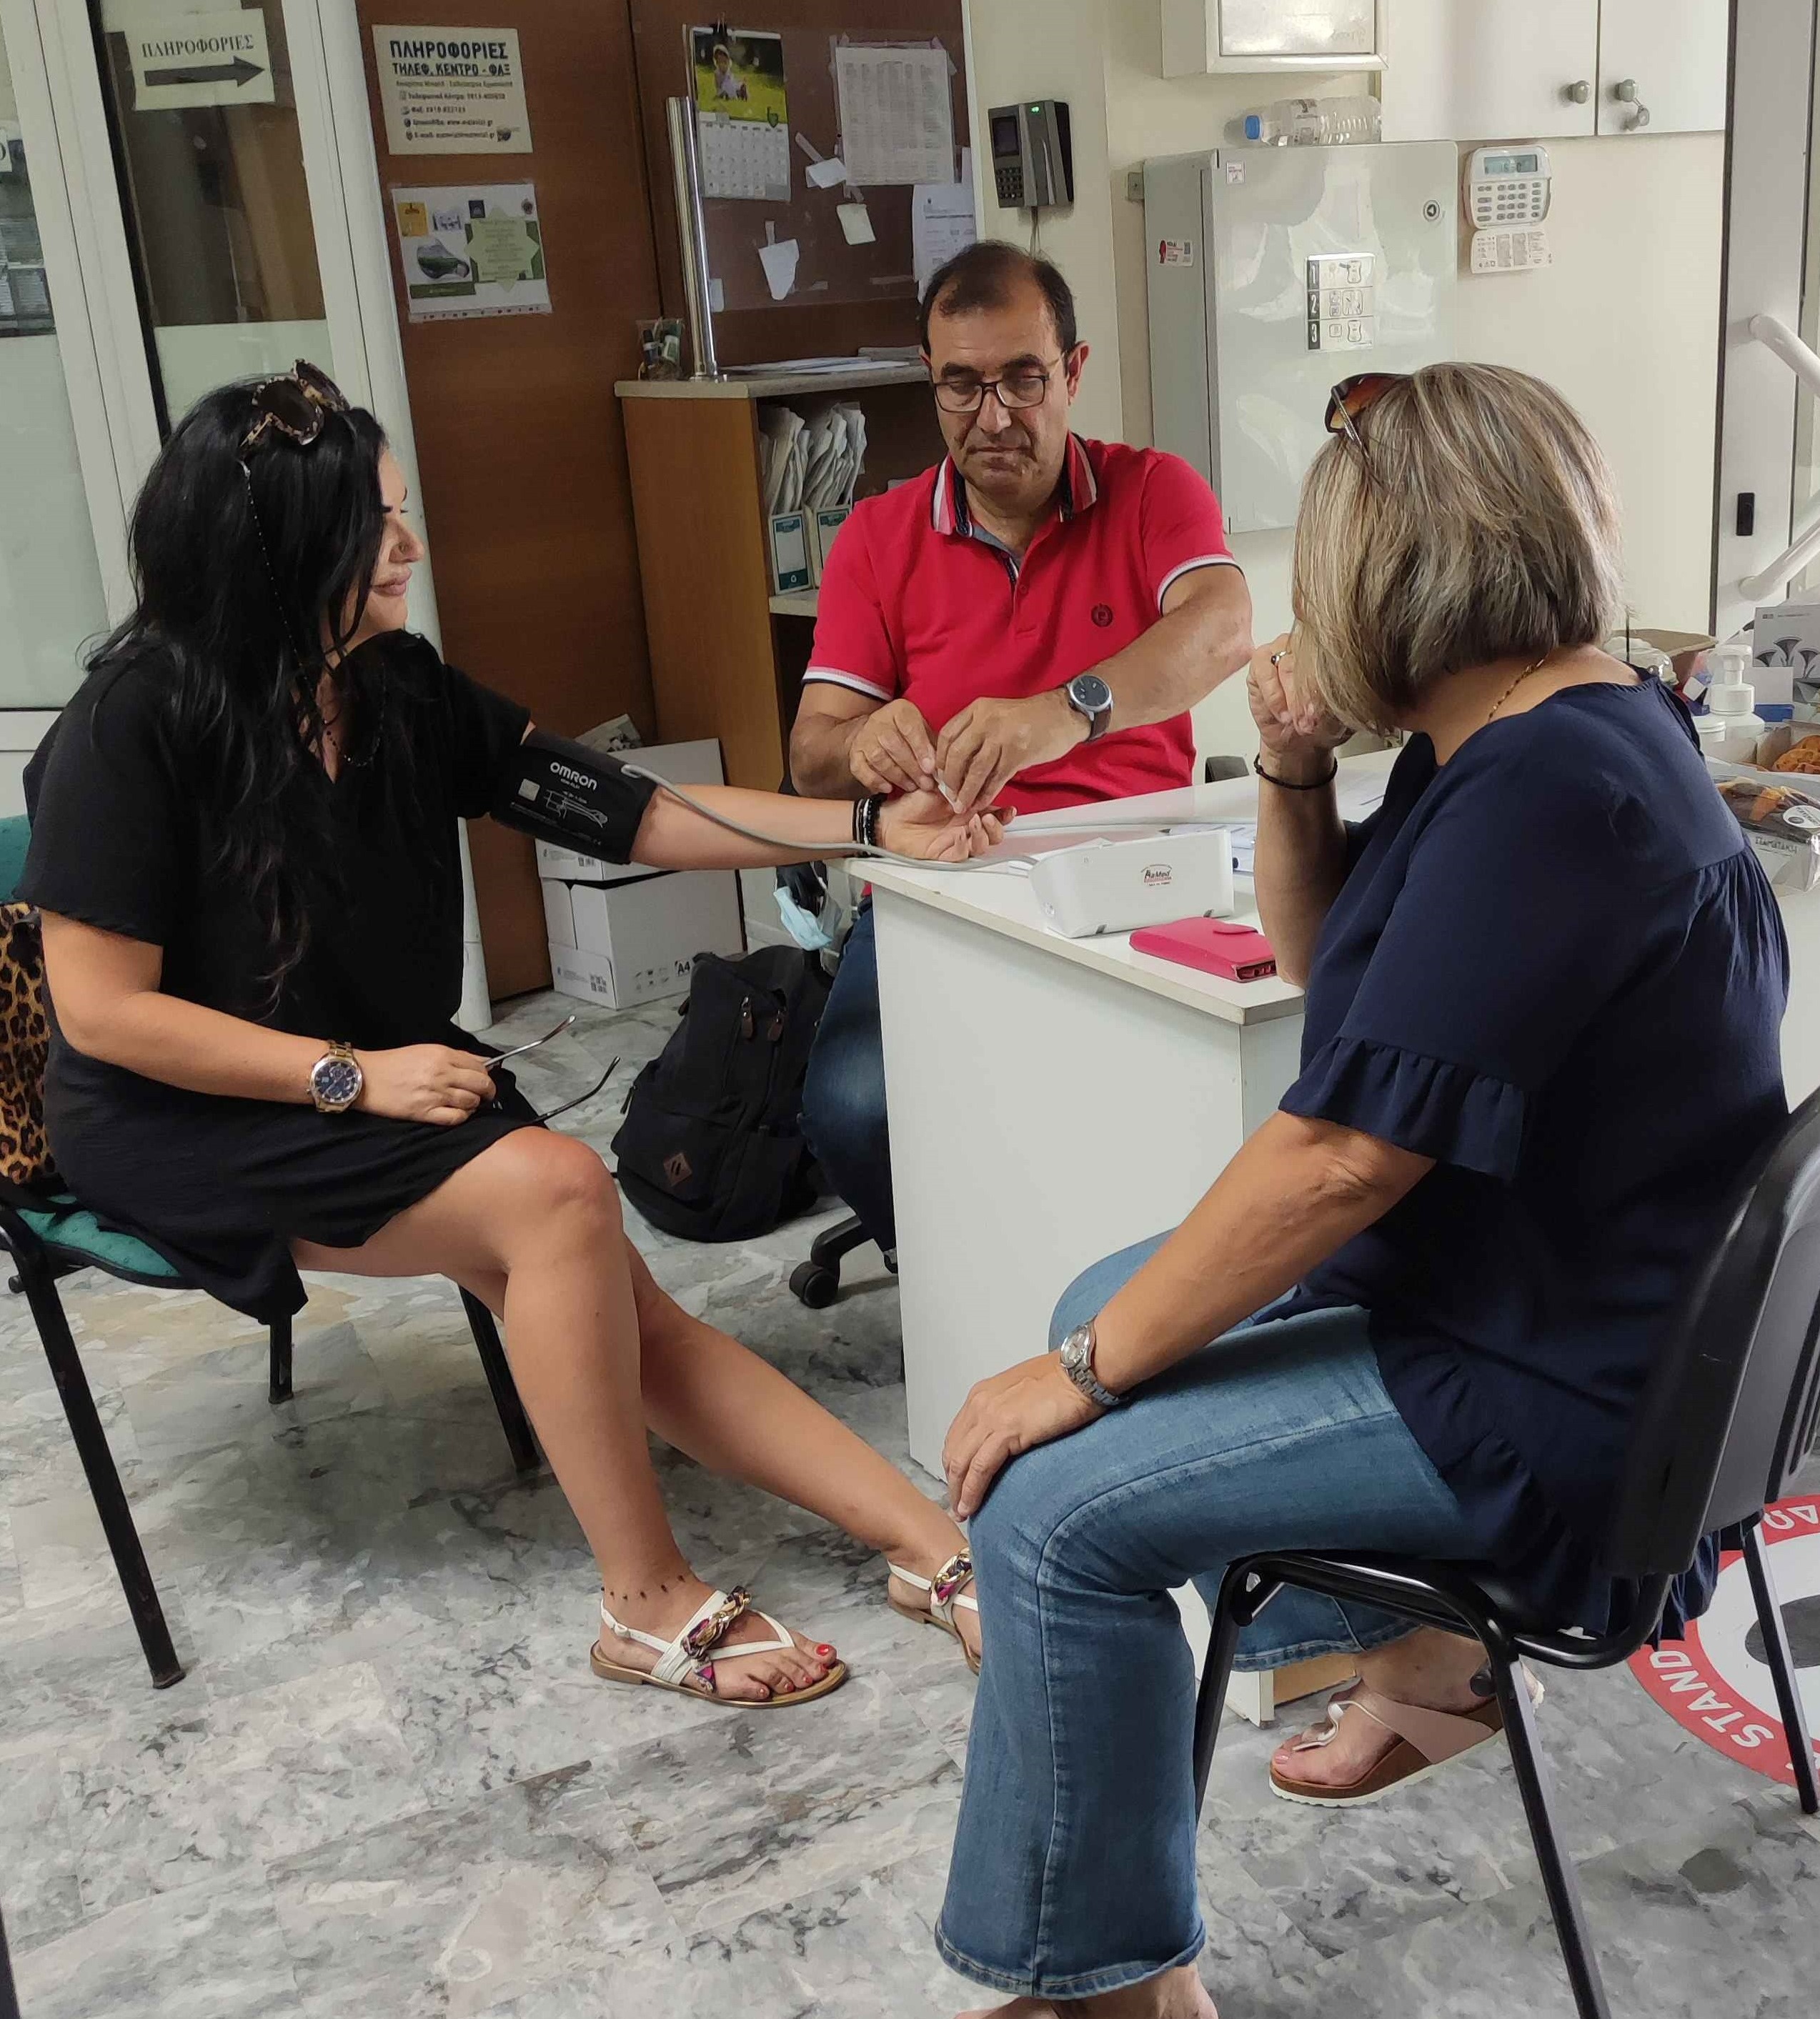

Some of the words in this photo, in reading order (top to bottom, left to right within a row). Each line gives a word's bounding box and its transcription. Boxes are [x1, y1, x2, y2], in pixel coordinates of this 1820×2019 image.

[142, 34, 254, 57] ΠΛΗΡΟΦΟΡΙΕΣ
[390, 41, 508, 59] ΠΛΗΡΟΦΟΡΙΕΣ
[392, 62, 434, 76] ΤΗΛΕΦ.
[436, 63, 479, 76] ΚΕΝΤΡΟ
[488, 64, 511, 76] ΦΑΞ
[1311, 264, 1316, 284] 1
[1311, 294, 1318, 314] 2
[1311, 324, 1318, 343] 3
[677, 961, 691, 977] A4
[1649, 1650, 1775, 1748] STAND
